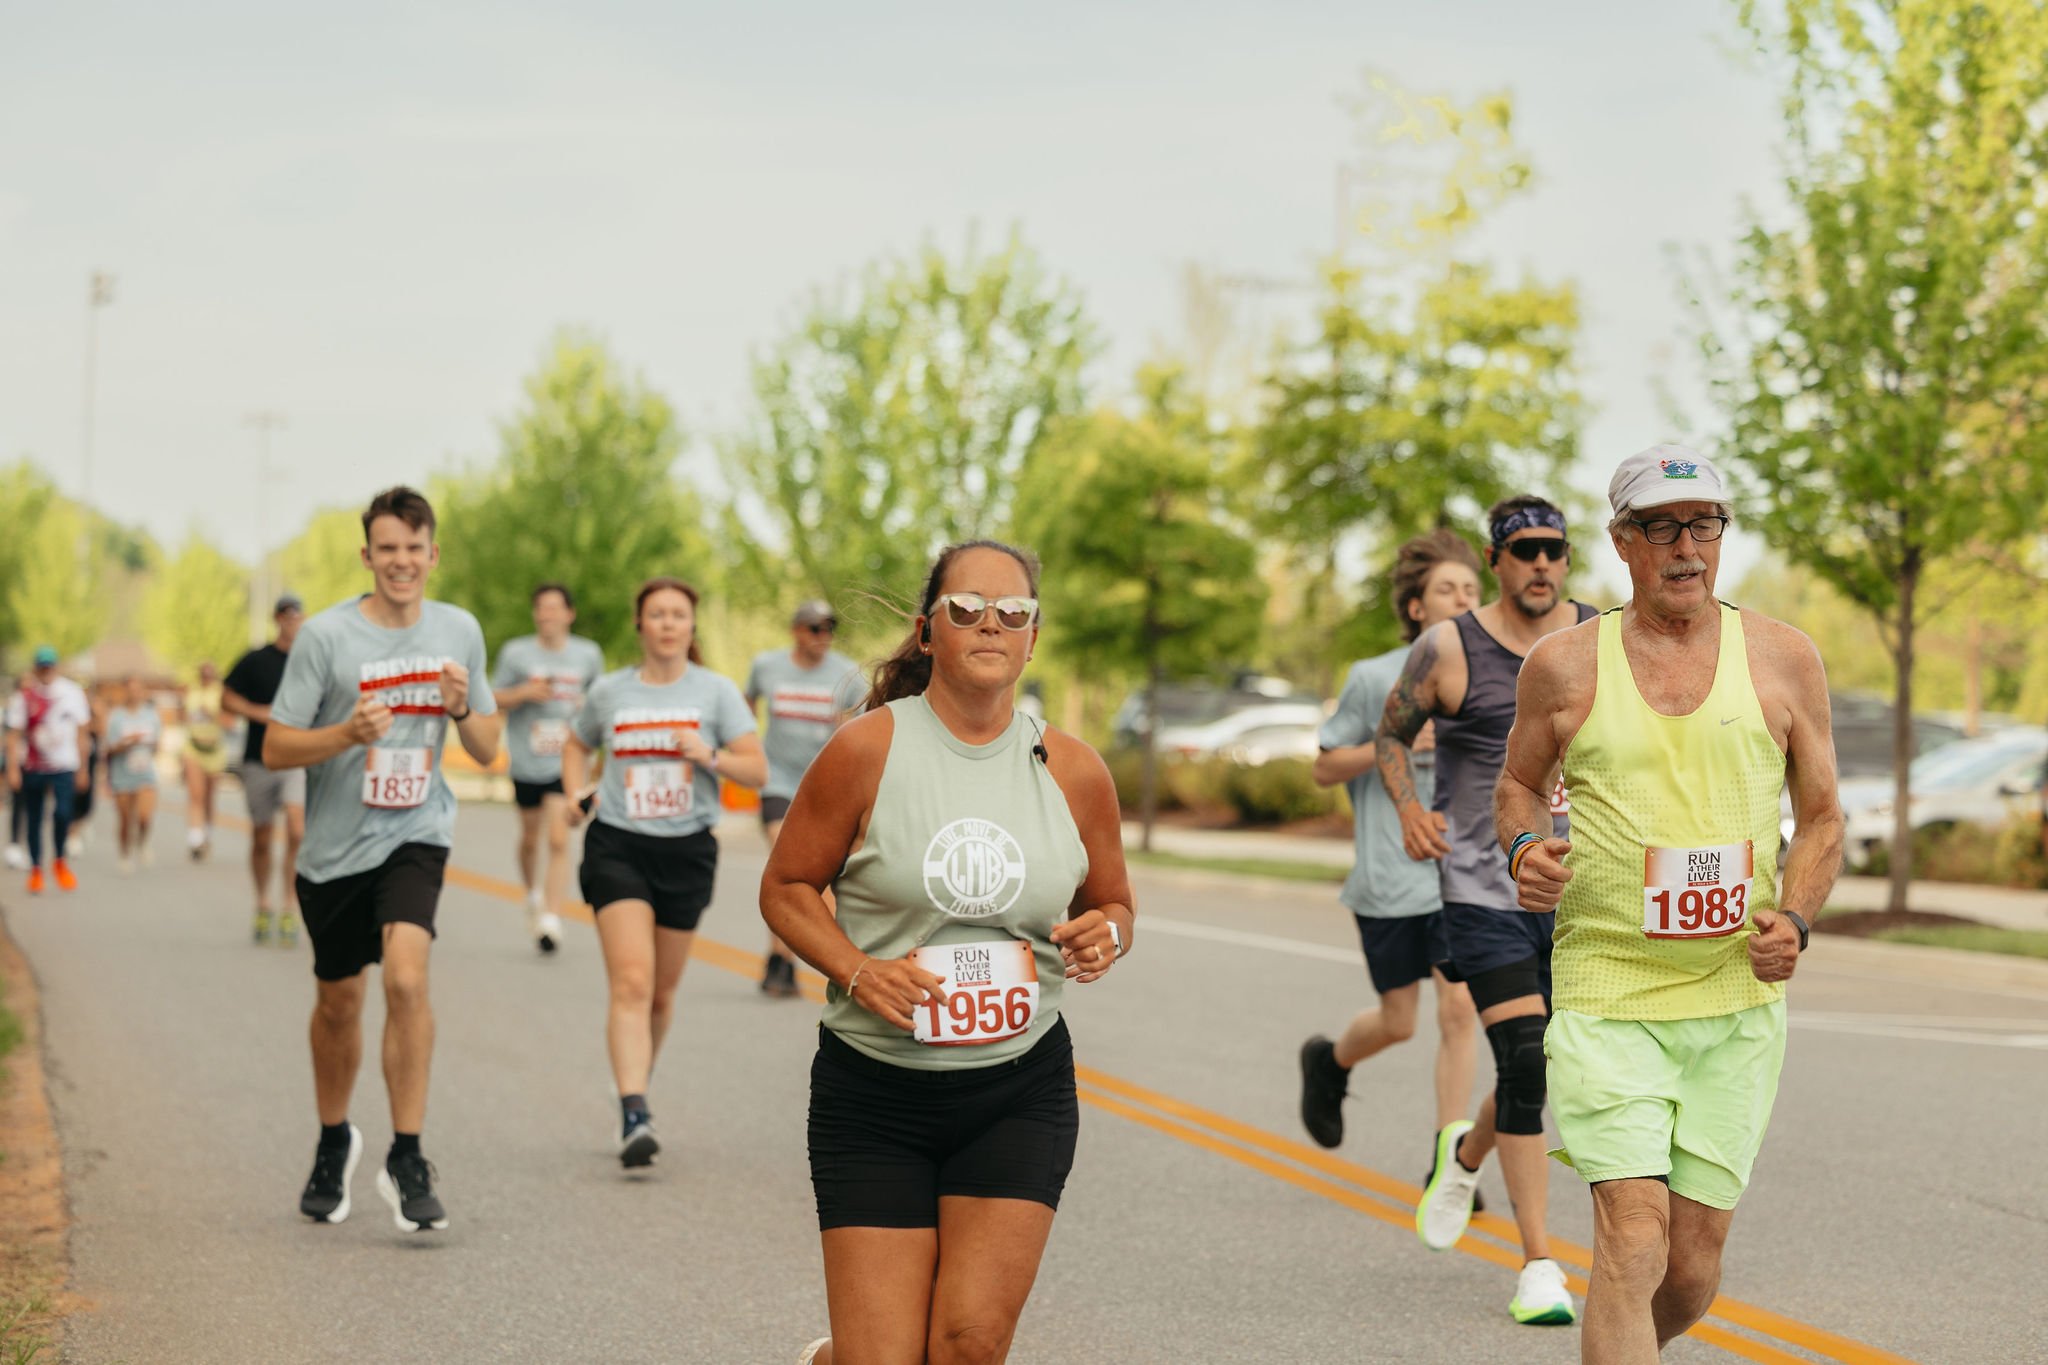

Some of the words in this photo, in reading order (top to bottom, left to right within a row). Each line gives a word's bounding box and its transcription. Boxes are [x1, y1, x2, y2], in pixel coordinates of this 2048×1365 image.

[371, 776, 426, 801] 1837
[634, 788, 689, 816] 1940
[1688, 852, 1720, 866] RUN
[951, 842, 1002, 897] LMB
[1696, 864, 1720, 872] THEIR
[1688, 871, 1720, 882] LIVES
[950, 898, 998, 914] FITNESS
[1652, 884, 1746, 930] 1983
[954, 948, 990, 964] RUN
[955, 963, 961, 971] 4
[964, 962, 990, 971] THEIR
[955, 970, 991, 982] LIVES
[920, 987, 1031, 1037] 1956
